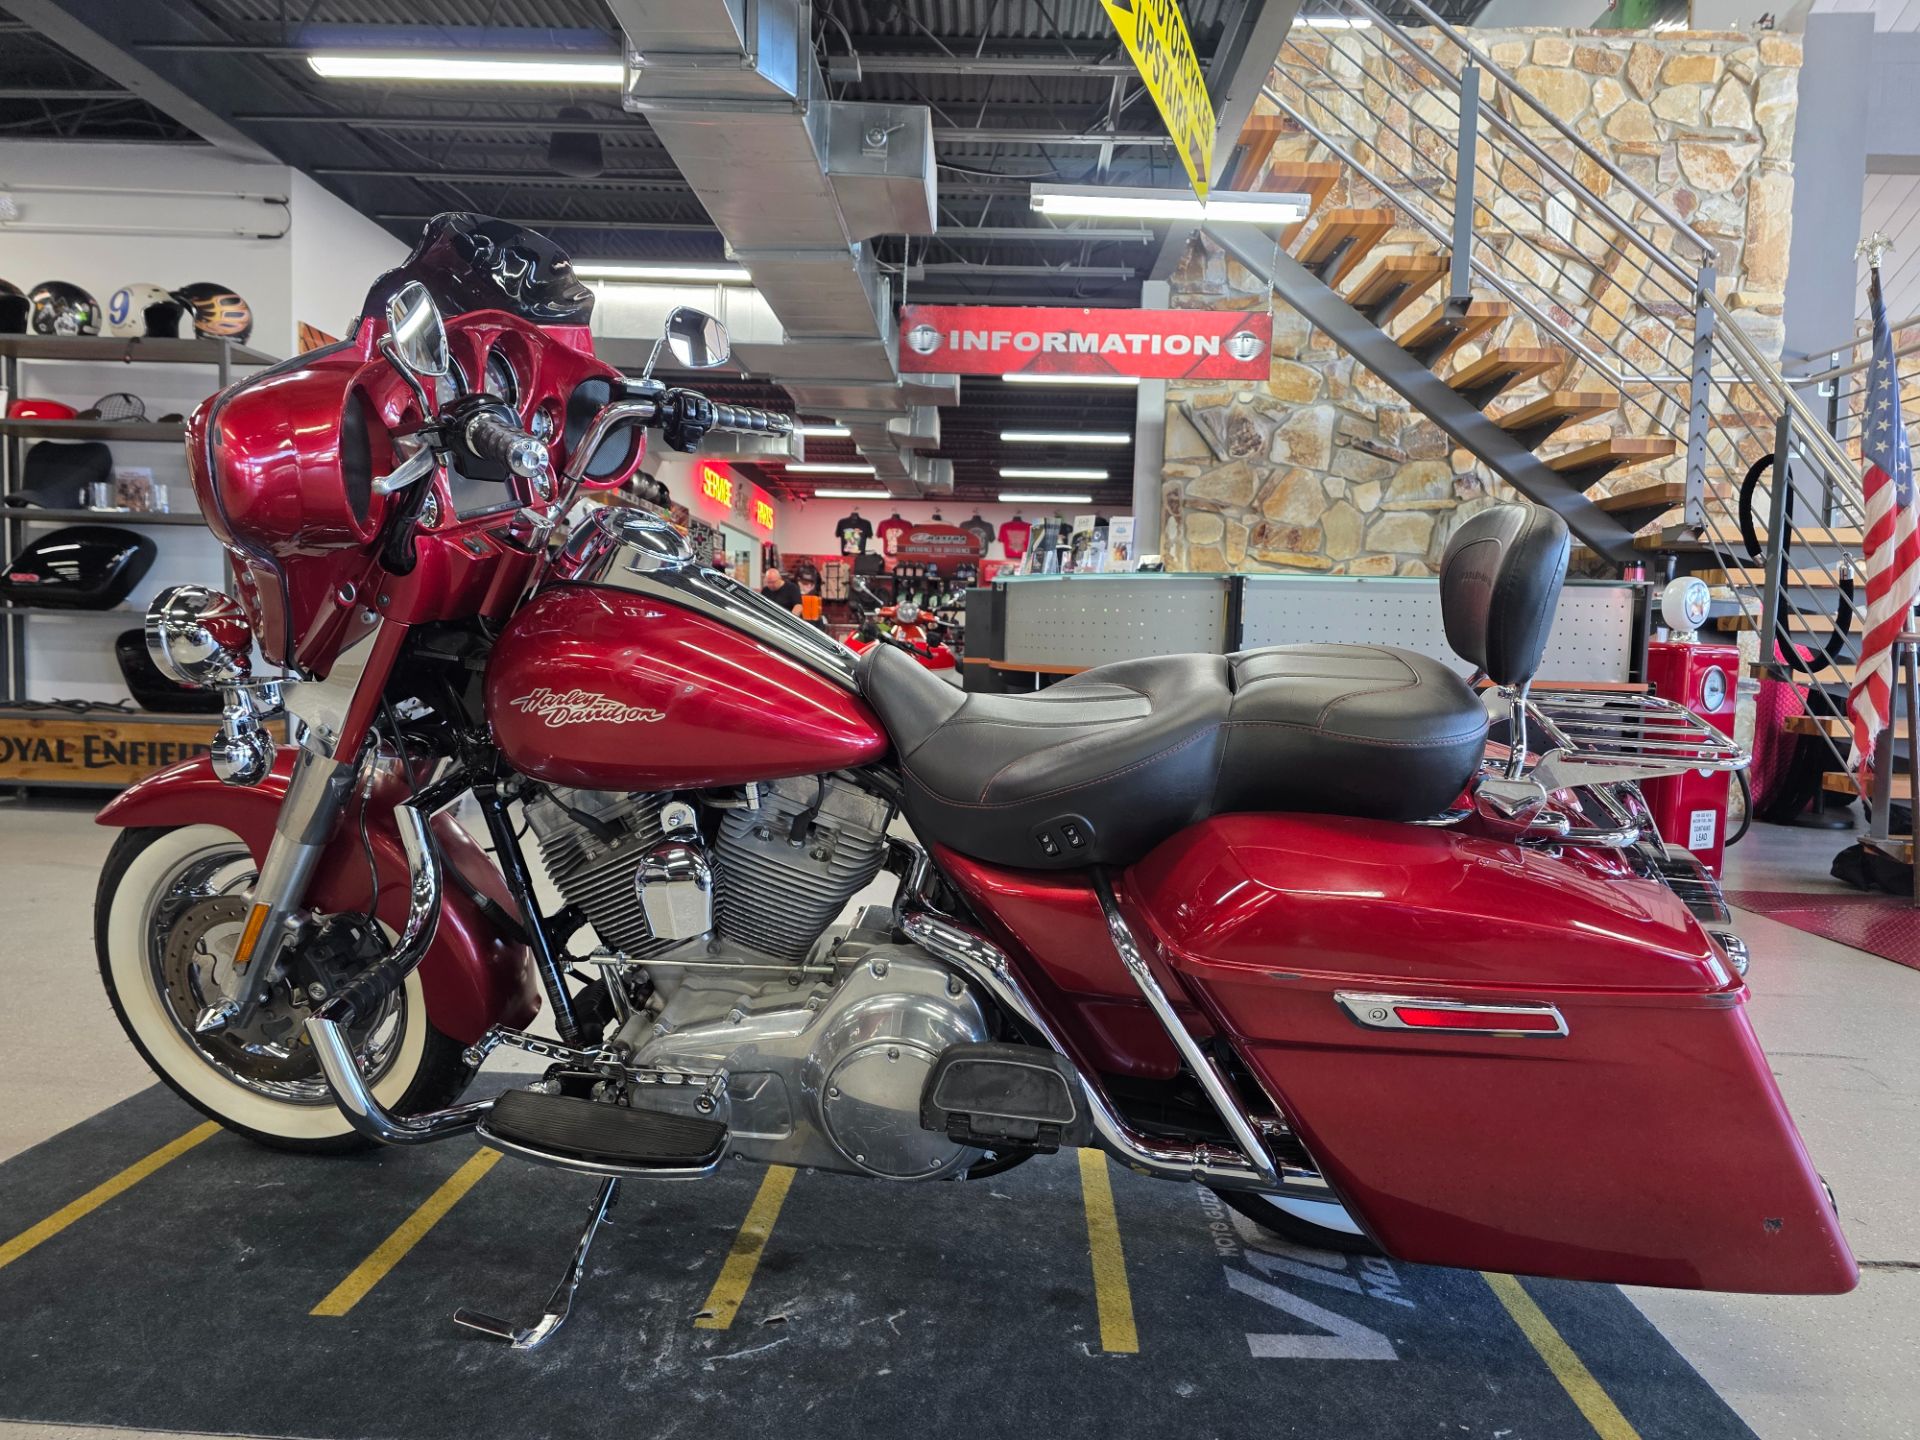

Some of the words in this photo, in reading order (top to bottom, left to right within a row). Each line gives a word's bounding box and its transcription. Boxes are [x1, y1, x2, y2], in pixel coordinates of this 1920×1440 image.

[1135, 0, 1189, 145] UPSTAIRS
[109, 290, 130, 326] 9
[949, 329, 1220, 357] INFORMATION
[703, 466, 733, 509] SERVICE
[756, 500, 774, 531] PARTS
[509, 688, 605, 713] Harley
[537, 703, 666, 728] Davidson
[1696, 833, 1708, 842] LEAD
[1209, 1221, 1240, 1257] MOTO
